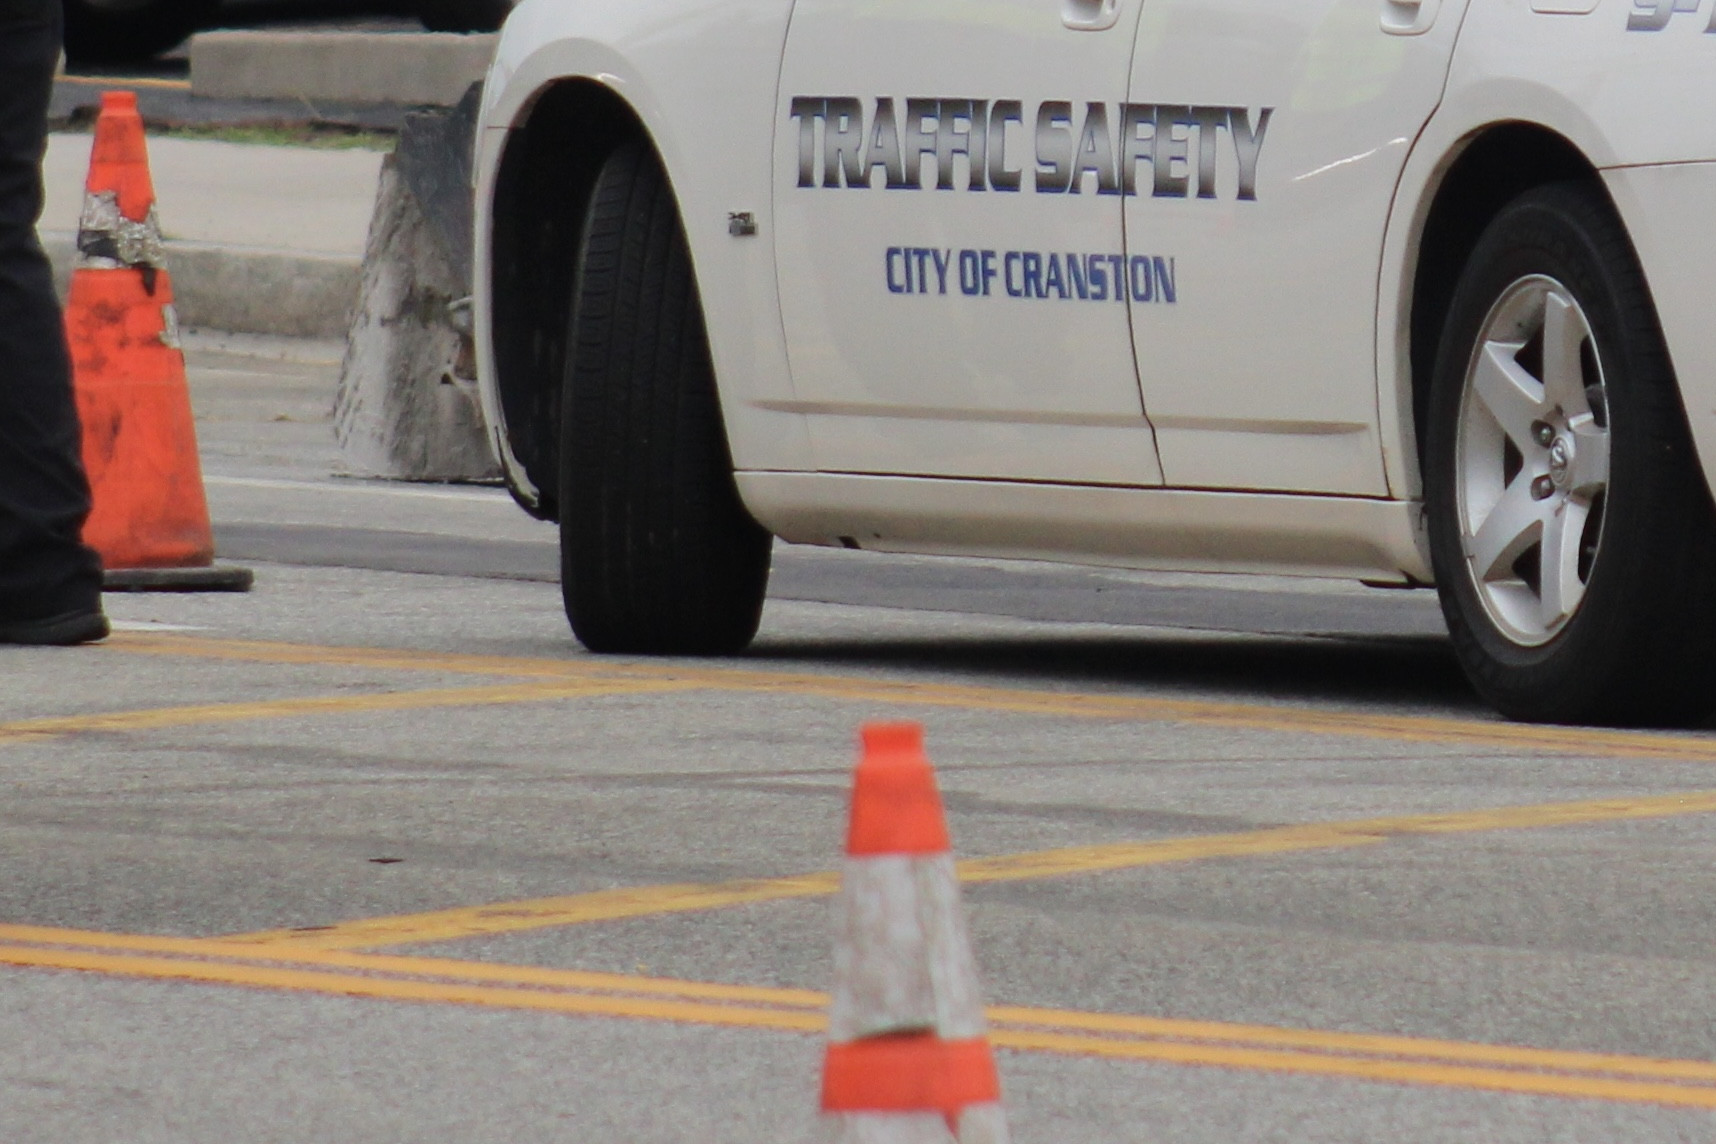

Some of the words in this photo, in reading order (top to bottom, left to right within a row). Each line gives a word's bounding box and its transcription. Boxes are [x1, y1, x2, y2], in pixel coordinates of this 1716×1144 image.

[790, 96, 1023, 193] TRAFFIC
[1034, 99, 1276, 201] SAFETY
[886, 246, 951, 295] CITY
[958, 249, 998, 296] OF
[1004, 251, 1178, 304] CRANSTON
